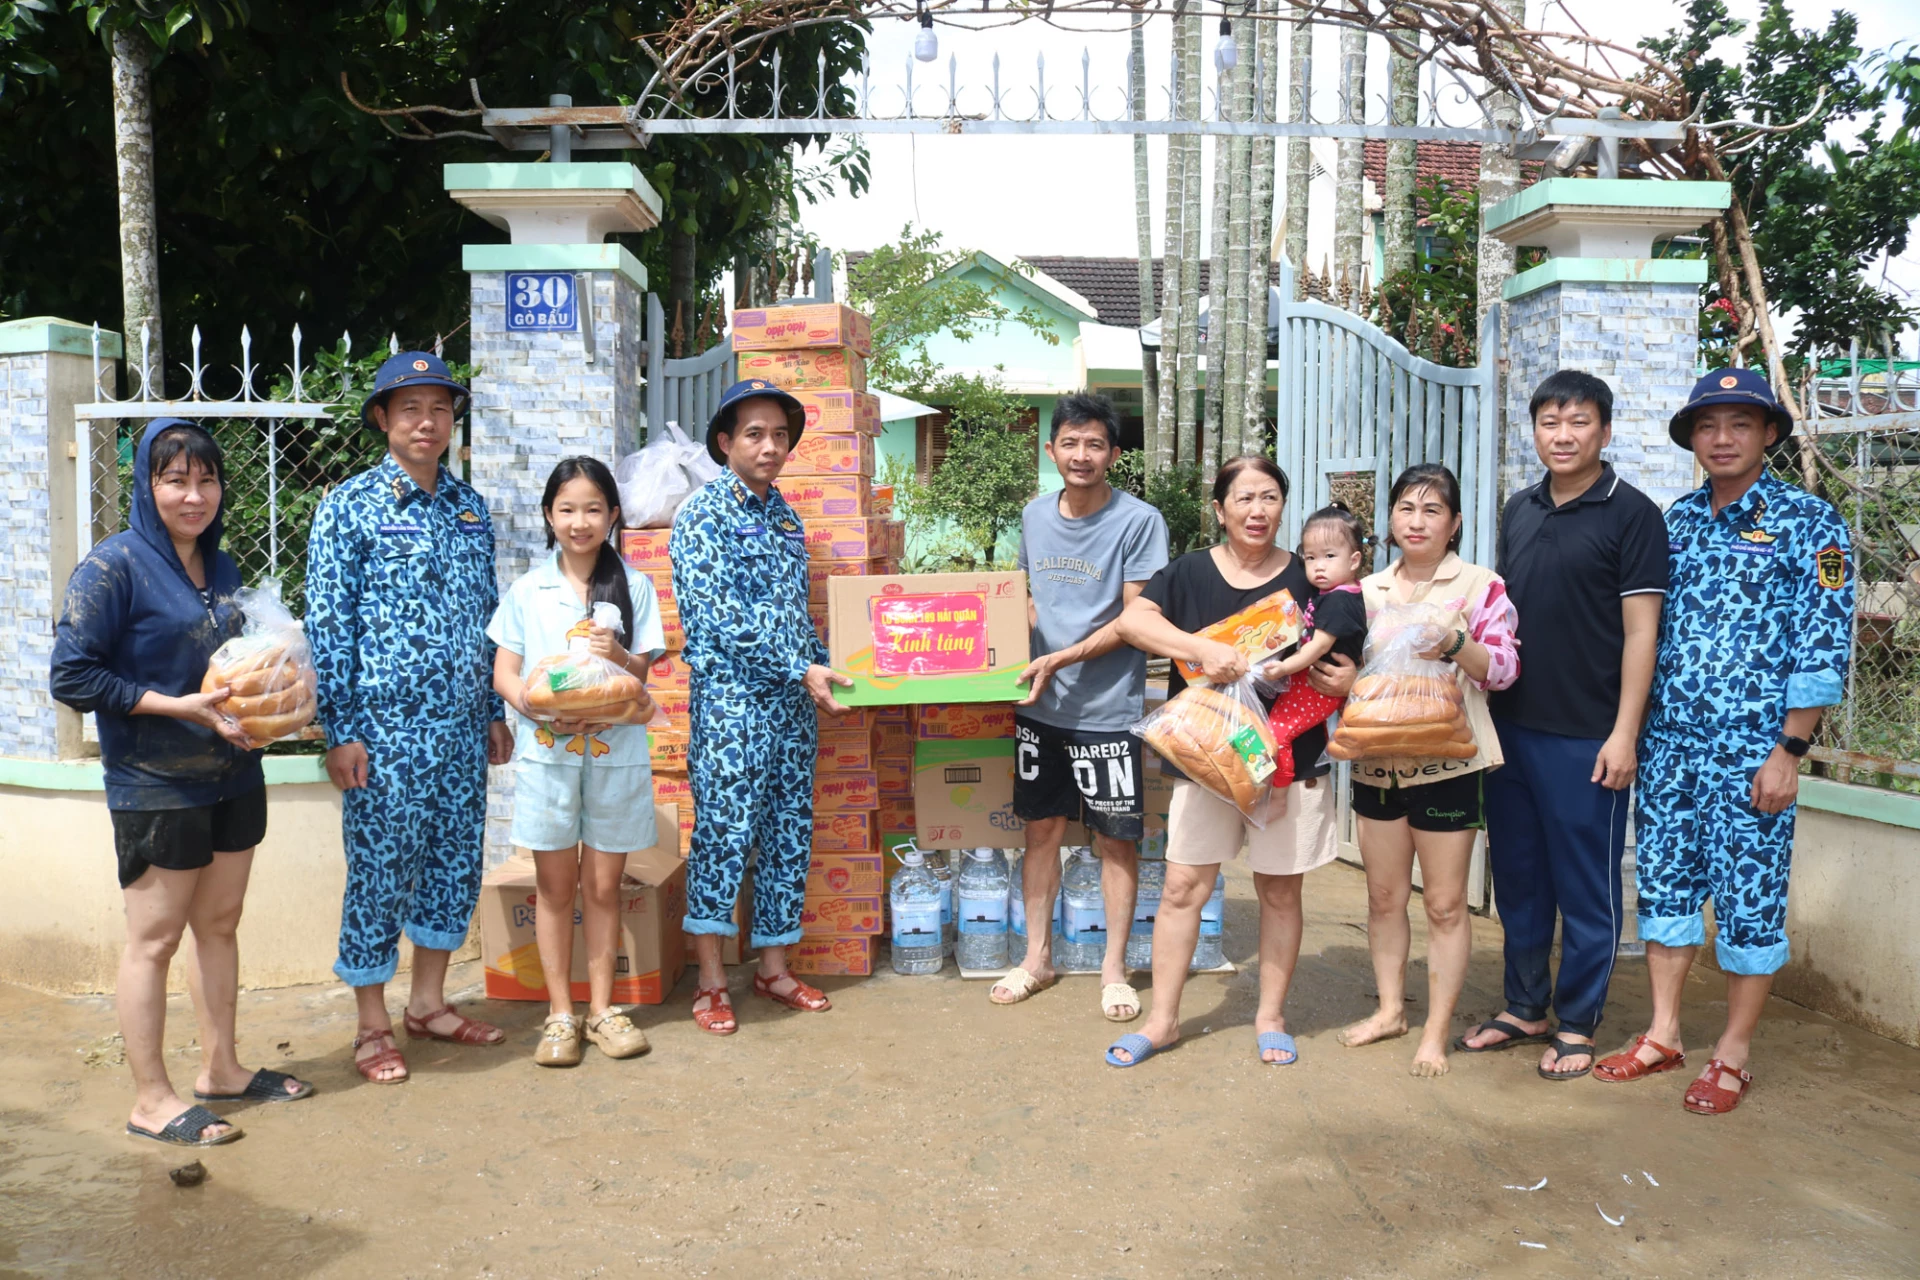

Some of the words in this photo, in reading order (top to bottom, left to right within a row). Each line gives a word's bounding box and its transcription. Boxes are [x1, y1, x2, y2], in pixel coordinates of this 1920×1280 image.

[515, 276, 568, 307] 30
[515, 310, 535, 325] GÒ
[1034, 556, 1103, 582] CALIFORNIA
[1048, 573, 1064, 582] WEST
[1066, 575, 1087, 586] COAST
[937, 607, 952, 622] HẢI
[953, 608, 977, 622] QUÂN
[937, 632, 976, 656] tặng
[1068, 741, 1130, 759] UARED2
[1018, 742, 1040, 781] C
[1107, 756, 1135, 798] N
[1426, 807, 1466, 822] Champion
